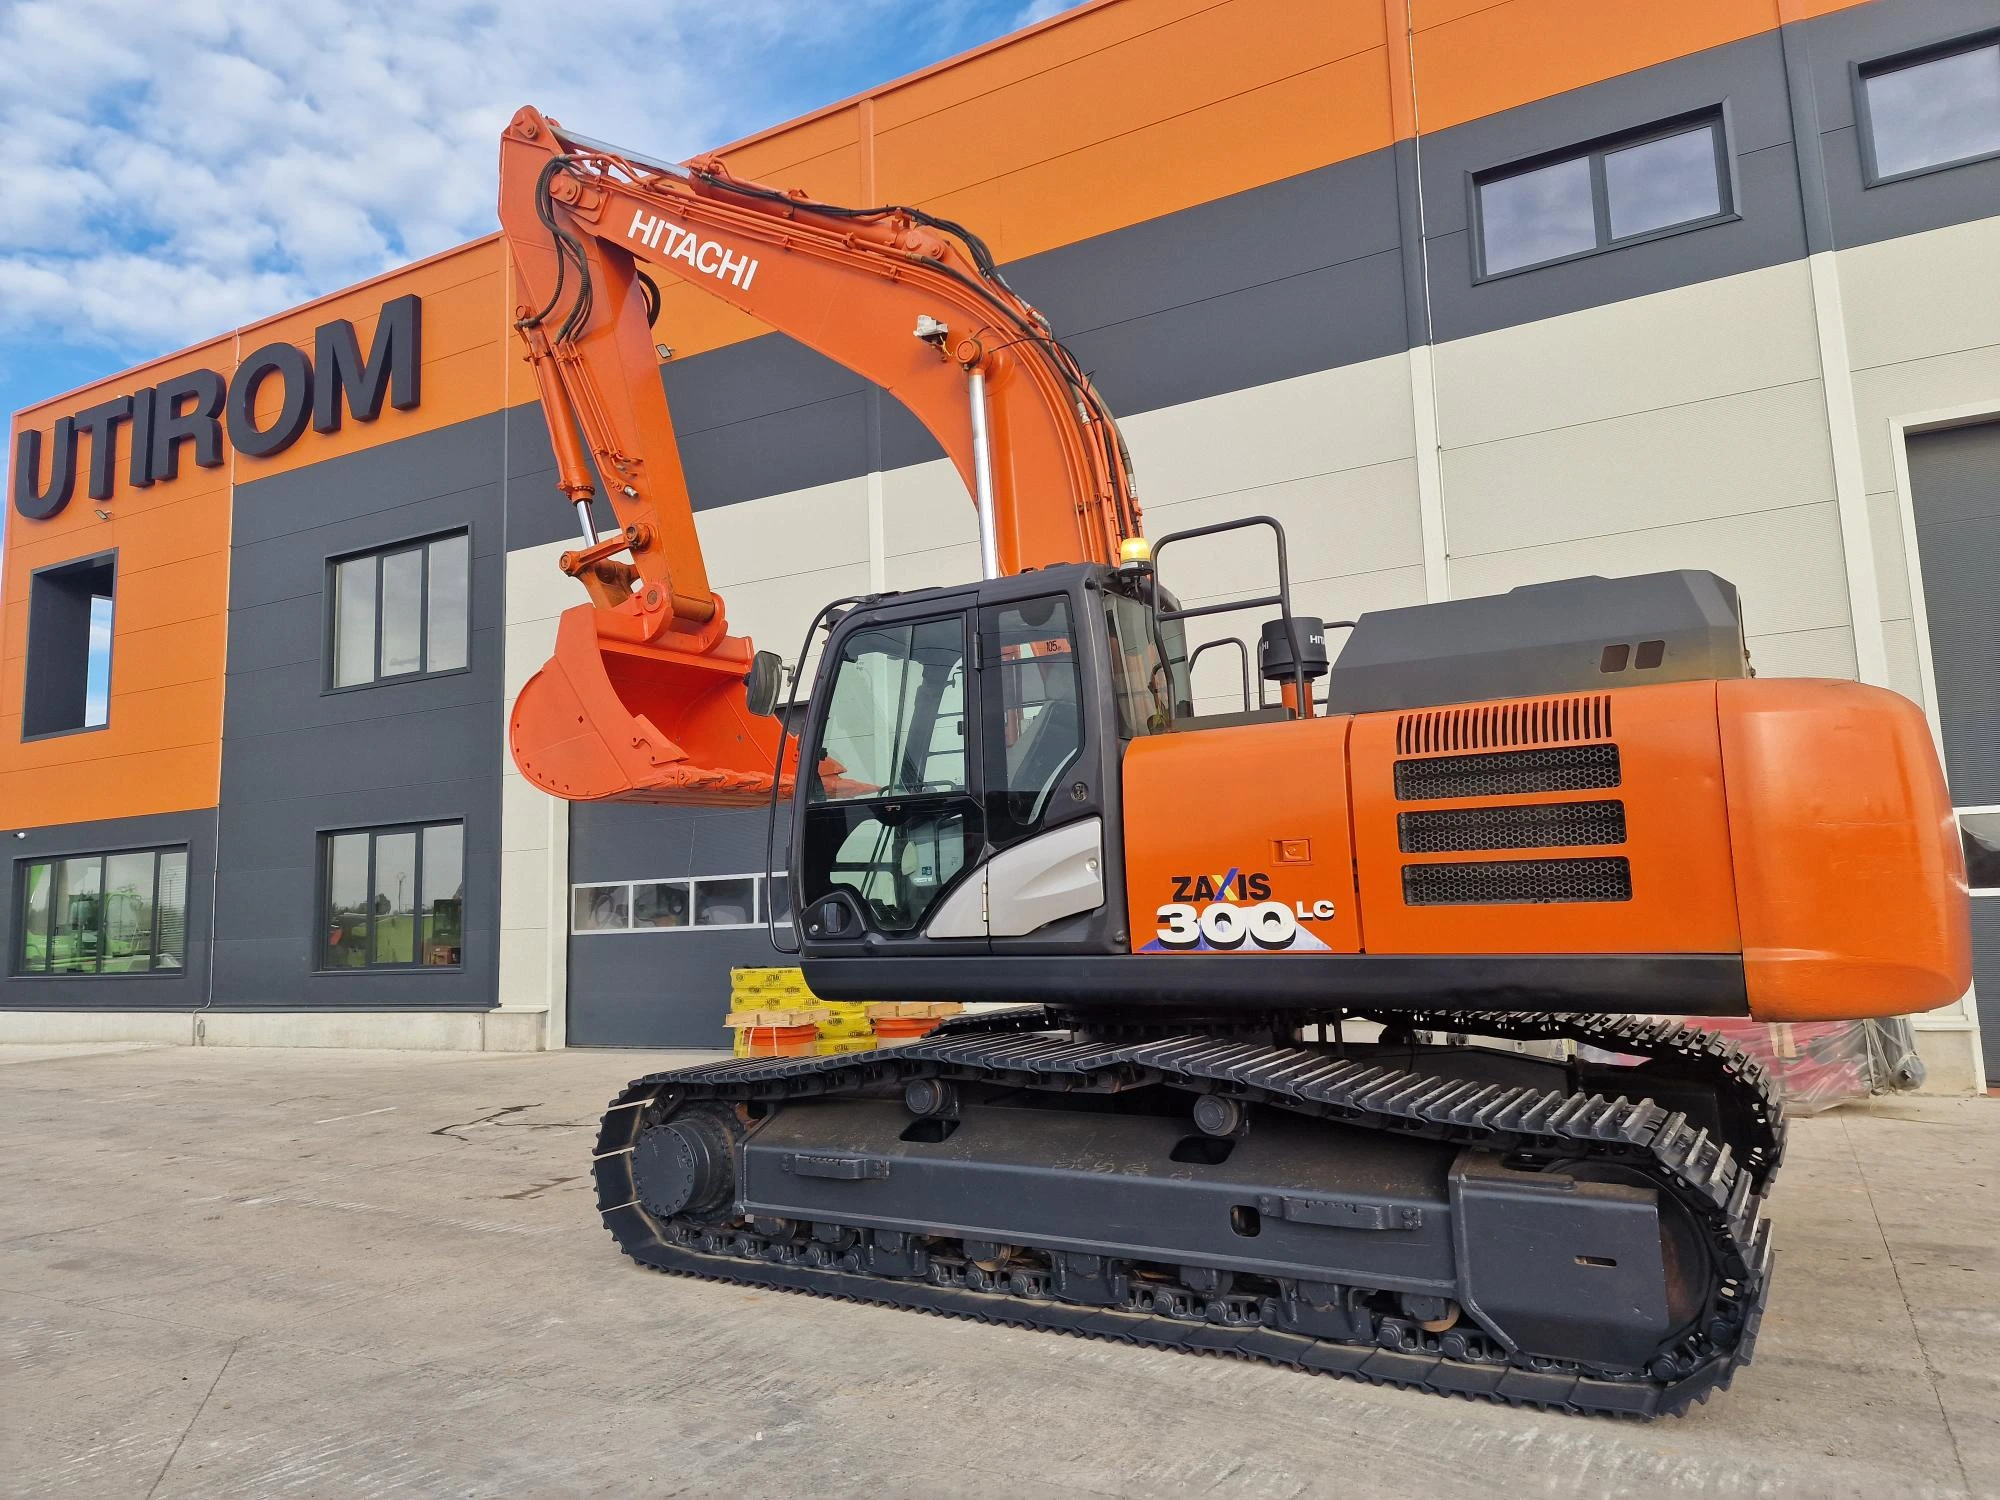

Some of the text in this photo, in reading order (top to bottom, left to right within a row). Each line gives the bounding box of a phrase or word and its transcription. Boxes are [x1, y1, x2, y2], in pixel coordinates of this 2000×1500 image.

[627, 209, 759, 291] HITACHI
[14, 293, 422, 520] UTIROM
[1046, 640, 1057, 652] 105
[1171, 867, 1272, 902] ZAXIS
